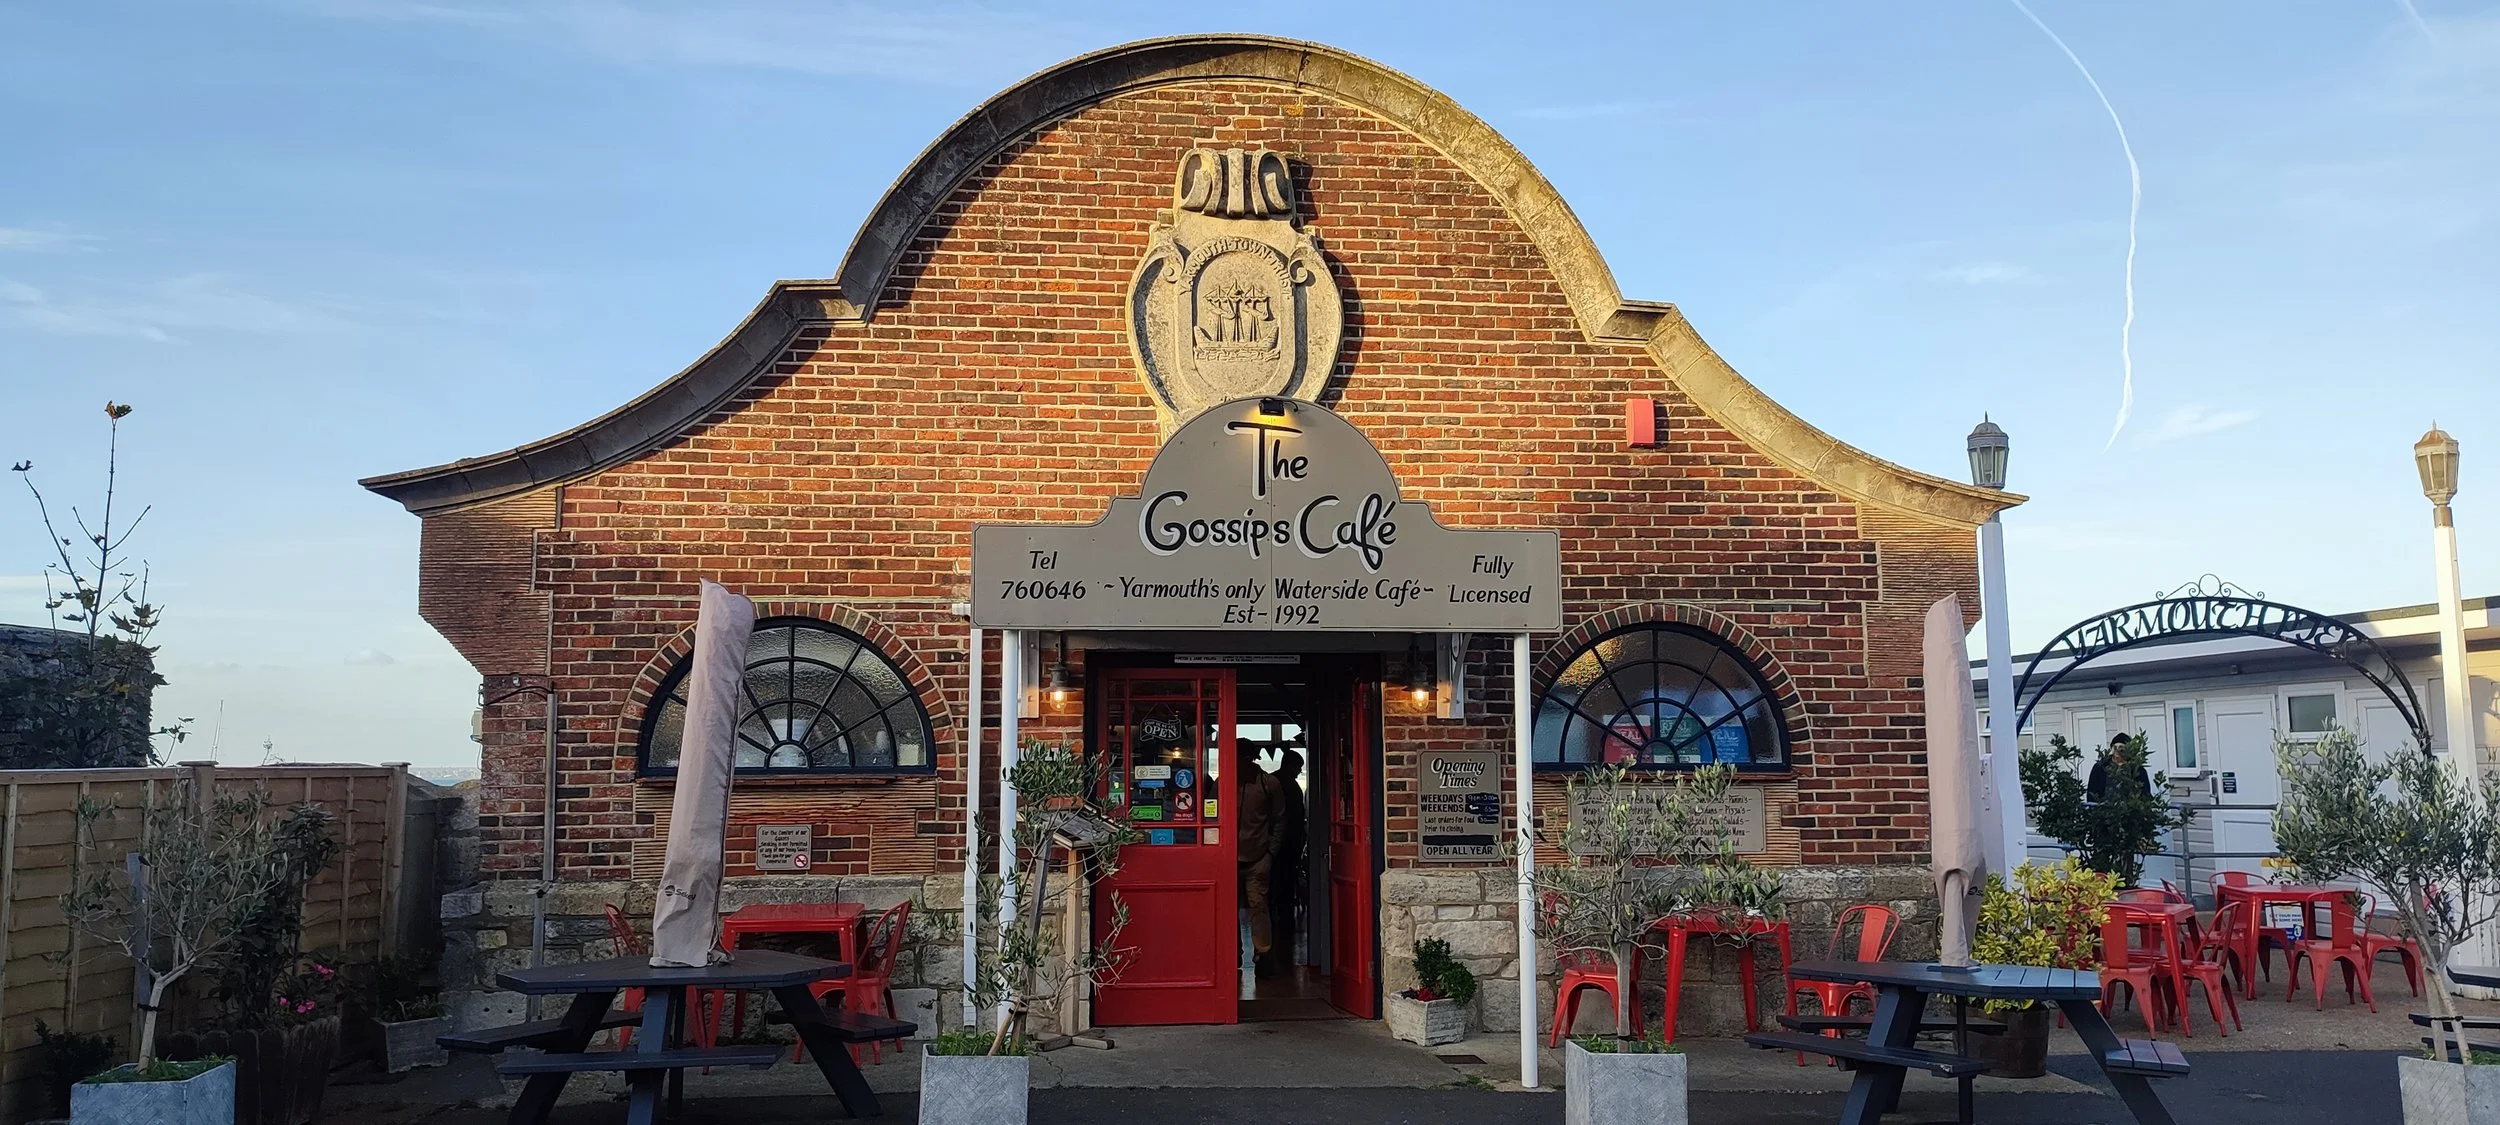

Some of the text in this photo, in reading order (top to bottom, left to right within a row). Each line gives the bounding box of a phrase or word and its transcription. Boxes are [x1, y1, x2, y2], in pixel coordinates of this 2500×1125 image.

[1224, 421, 1309, 500] The
[1139, 490, 1397, 574] Gossips Café
[1029, 550, 1058, 570] Tel
[1472, 555, 1515, 579] Fully
[1000, 580, 1087, 600] 760646
[1225, 578, 1266, 604] only
[1275, 578, 1368, 600] Waterside
[1449, 584, 1532, 603] Licensed
[1275, 604, 1320, 625] 1992
[2062, 601, 2269, 661] YARMOUTH
[1144, 724, 1178, 738] OPEN
[1431, 758, 1486, 777] Opening
[1440, 771, 1478, 789] Times
[1420, 794, 1464, 803] WEEKDAYS
[1420, 804, 1464, 813] WEEKENDS
[1426, 846, 1493, 856] OPEN ALL YEAR
